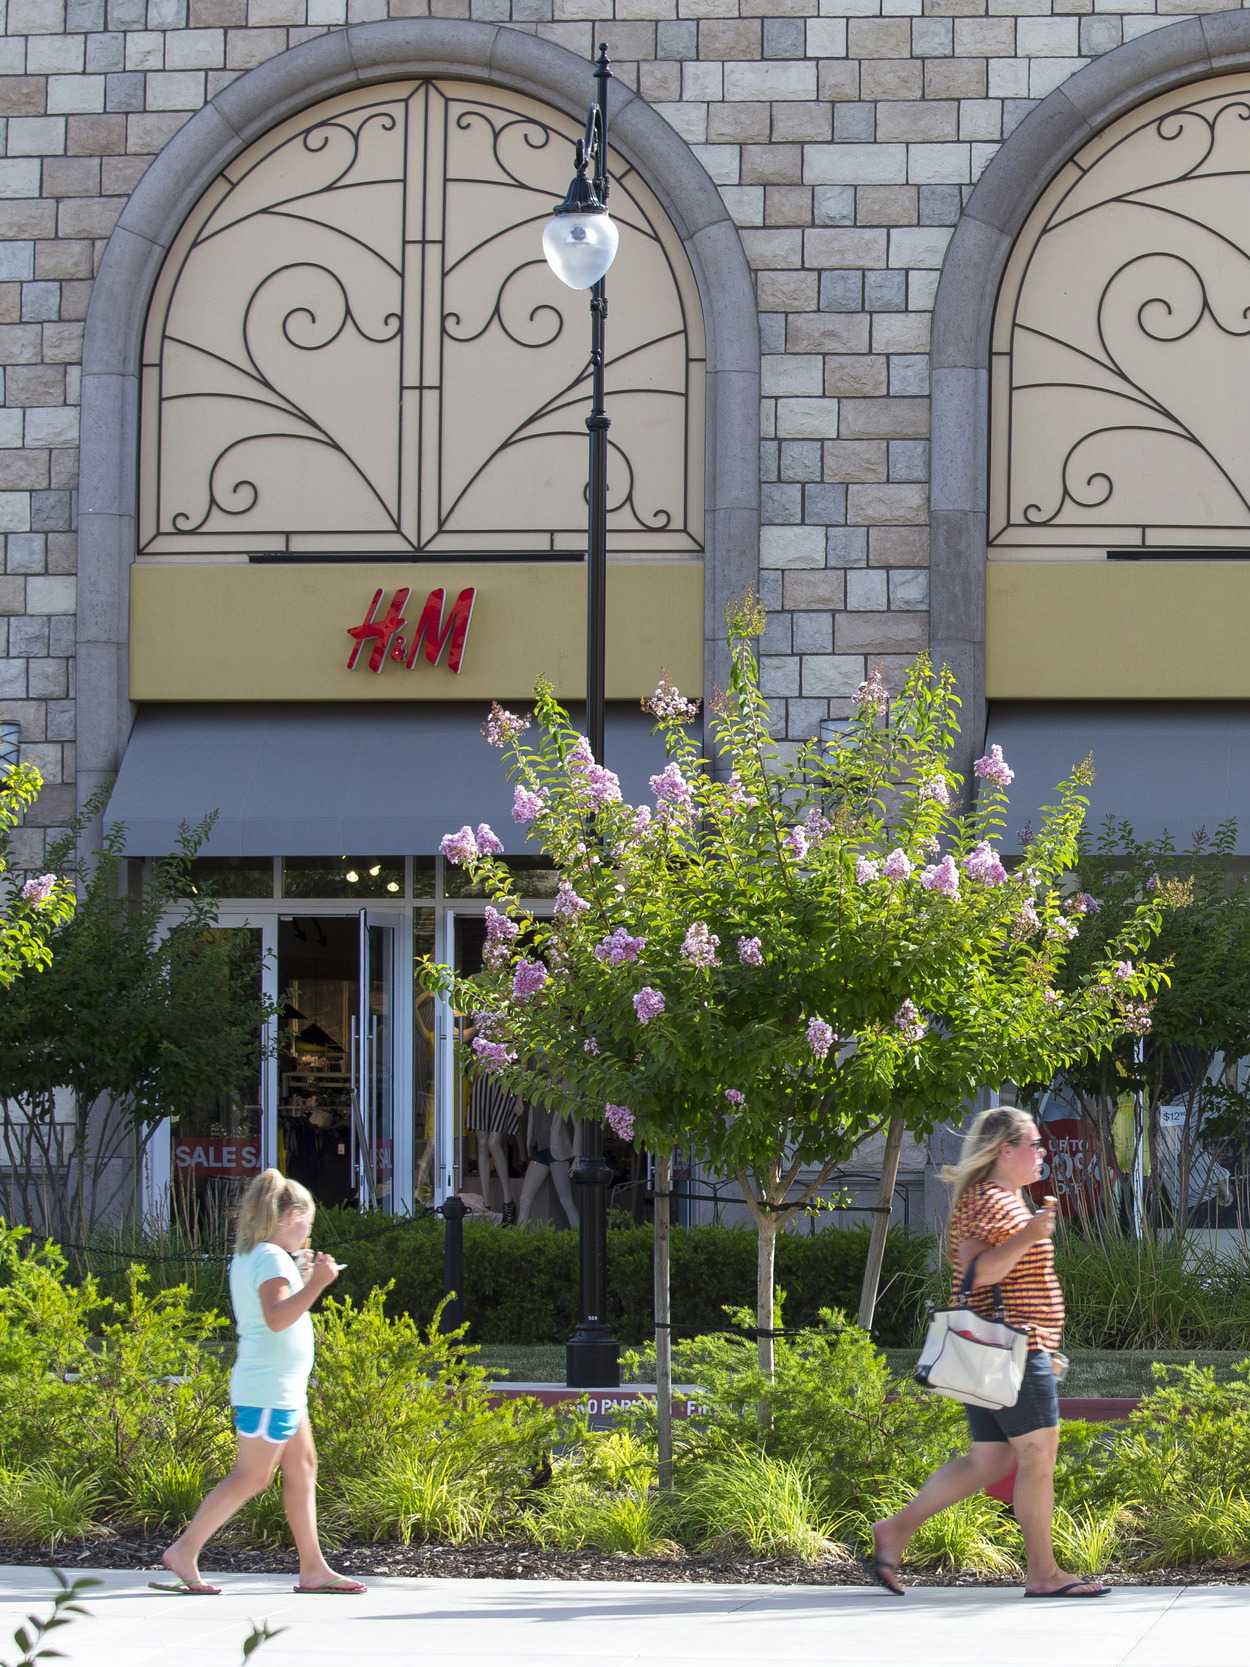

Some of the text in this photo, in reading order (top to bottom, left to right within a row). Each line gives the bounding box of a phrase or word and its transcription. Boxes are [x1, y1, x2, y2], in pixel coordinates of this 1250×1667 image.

[346, 587, 477, 673] H&M
[176, 1145, 262, 1168] SALE S
